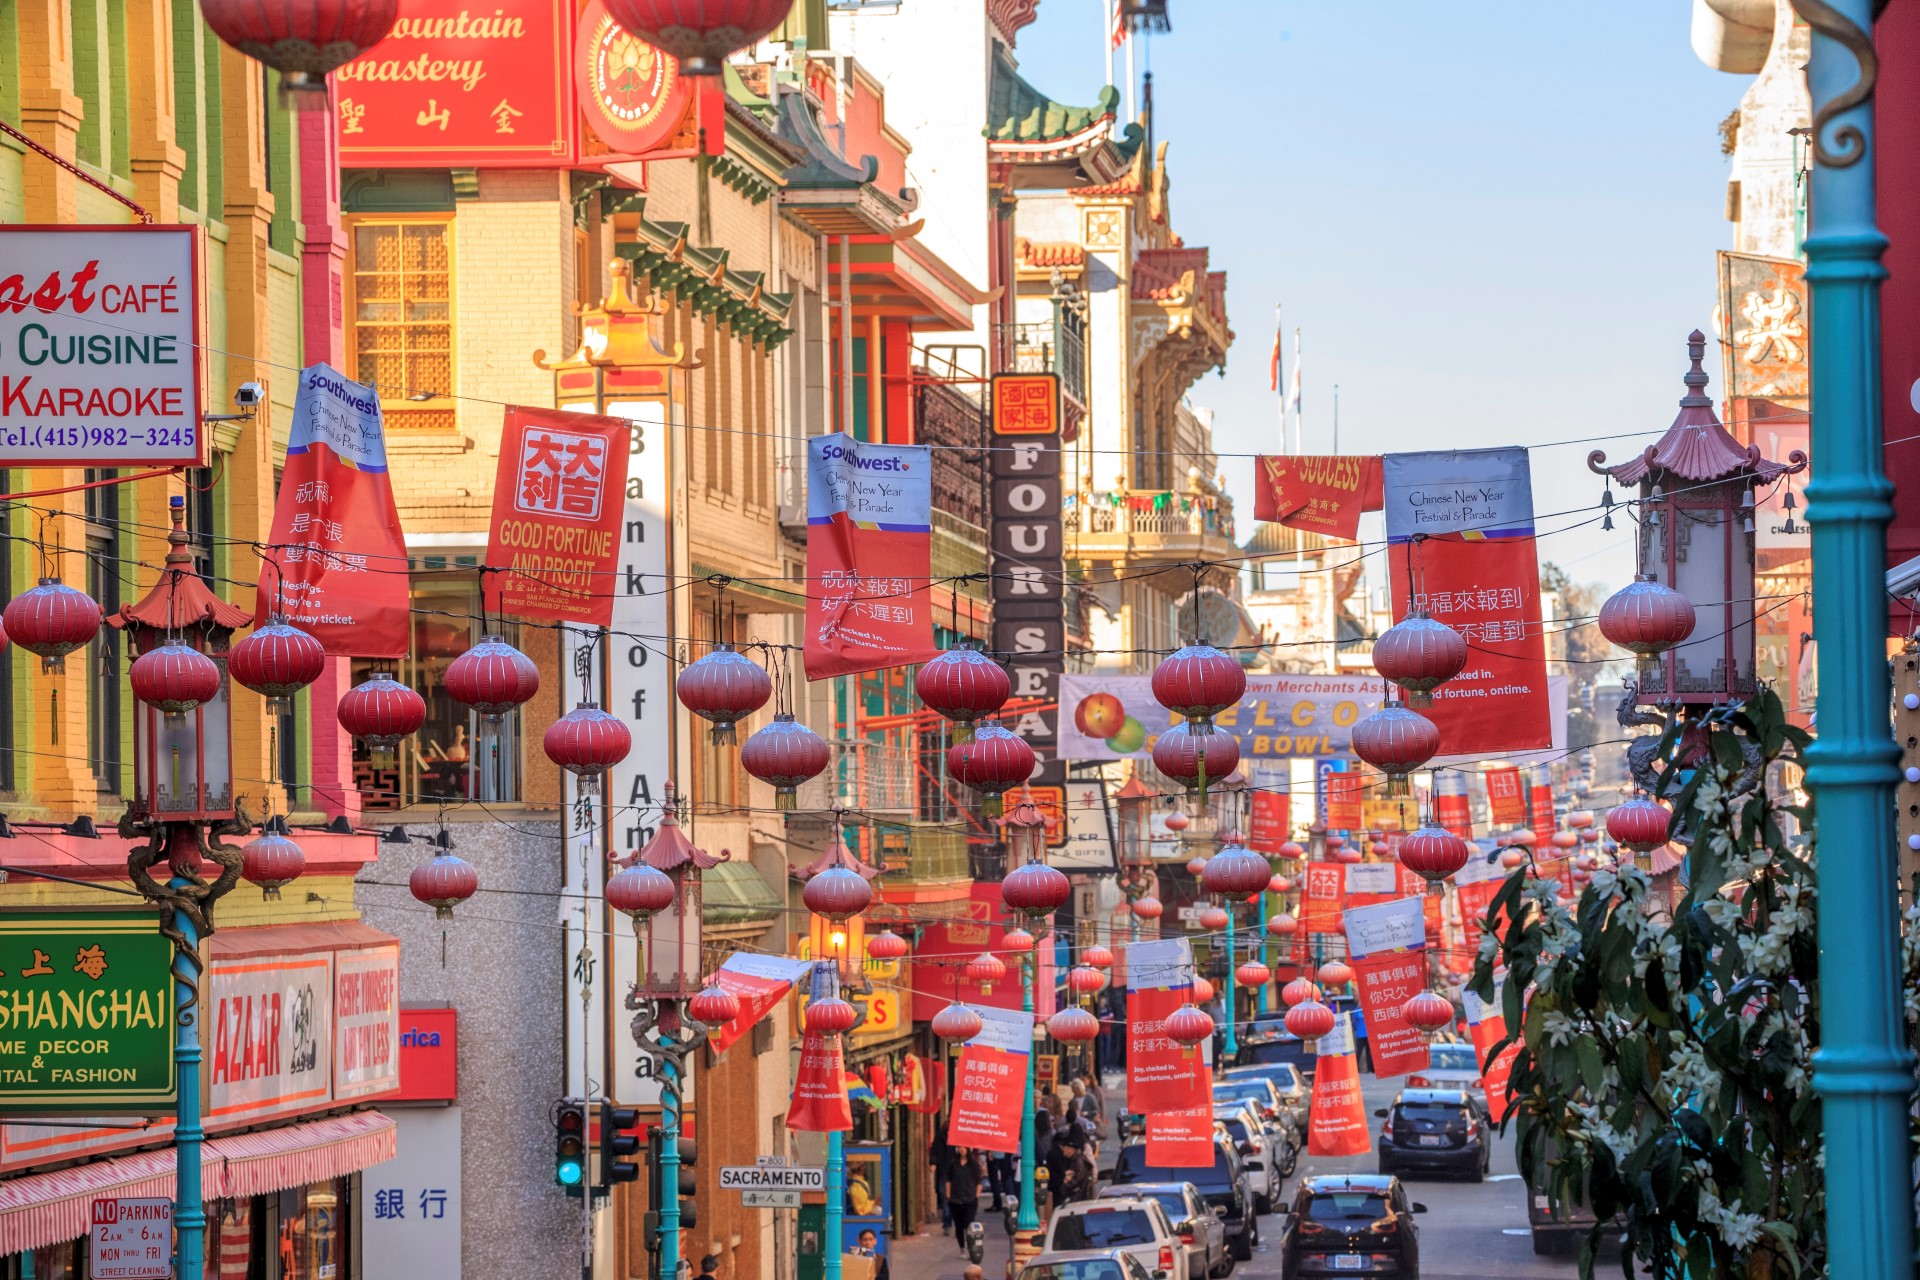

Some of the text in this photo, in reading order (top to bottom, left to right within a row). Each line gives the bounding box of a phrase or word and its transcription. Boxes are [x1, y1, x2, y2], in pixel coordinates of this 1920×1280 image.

[388, 9, 525, 39] ountain
[336, 53, 486, 92] onastery
[0, 260, 179, 314] ast CAFÉ
[19, 323, 178, 366] CUISINE
[2, 376, 183, 417] KARAOKE
[309, 374, 378, 416] Southwest
[310, 400, 381, 440] Chinese New Year
[342, 433, 372, 456] Parade
[822, 444, 900, 472] Southwest
[852, 481, 903, 496] New Year
[850, 498, 894, 513] & Parade
[1409, 488, 1504, 507] Chinese New Year
[1008, 442, 1049, 594] FOUR
[1415, 507, 1496, 524] Festival & Parade
[500, 519, 613, 558] GOOD FORTUNE
[508, 552, 596, 587] AND PROFIT
[314, 600, 321, 608] a
[502, 598, 525, 606] CHINESE
[561, 605, 592, 613] COMMERCE
[320, 614, 356, 625] ticket.
[1449, 619, 1525, 645] 不遲到
[1481, 669, 1495, 679] in.
[1276, 681, 1355, 694] Merchants
[1445, 687, 1488, 699] fortune,
[1490, 684, 1531, 696] ontime.
[1253, 735, 1336, 755] BOWL
[1369, 986, 1410, 1004] 你只欠
[0, 989, 165, 1030] SHANGHAI
[1132, 1020, 1165, 1034] 祝福來
[1377, 1027, 1414, 1040] Everything's
[0, 1040, 109, 1054] ME DECOR
[1381, 1046, 1424, 1059] Southwesterly
[1389, 1041, 1400, 1050] you
[32, 1055, 44, 1069] &
[52, 1068, 137, 1082] FASHION
[722, 1170, 821, 1186] SACRAMENTO
[95, 1201, 169, 1222] NO PARKING
[101, 1227, 109, 1242] 2
[141, 1225, 149, 1240] 6
[100, 1246, 161, 1261] MON THRU FRI
[100, 1266, 165, 1276] STREET CLEANING
